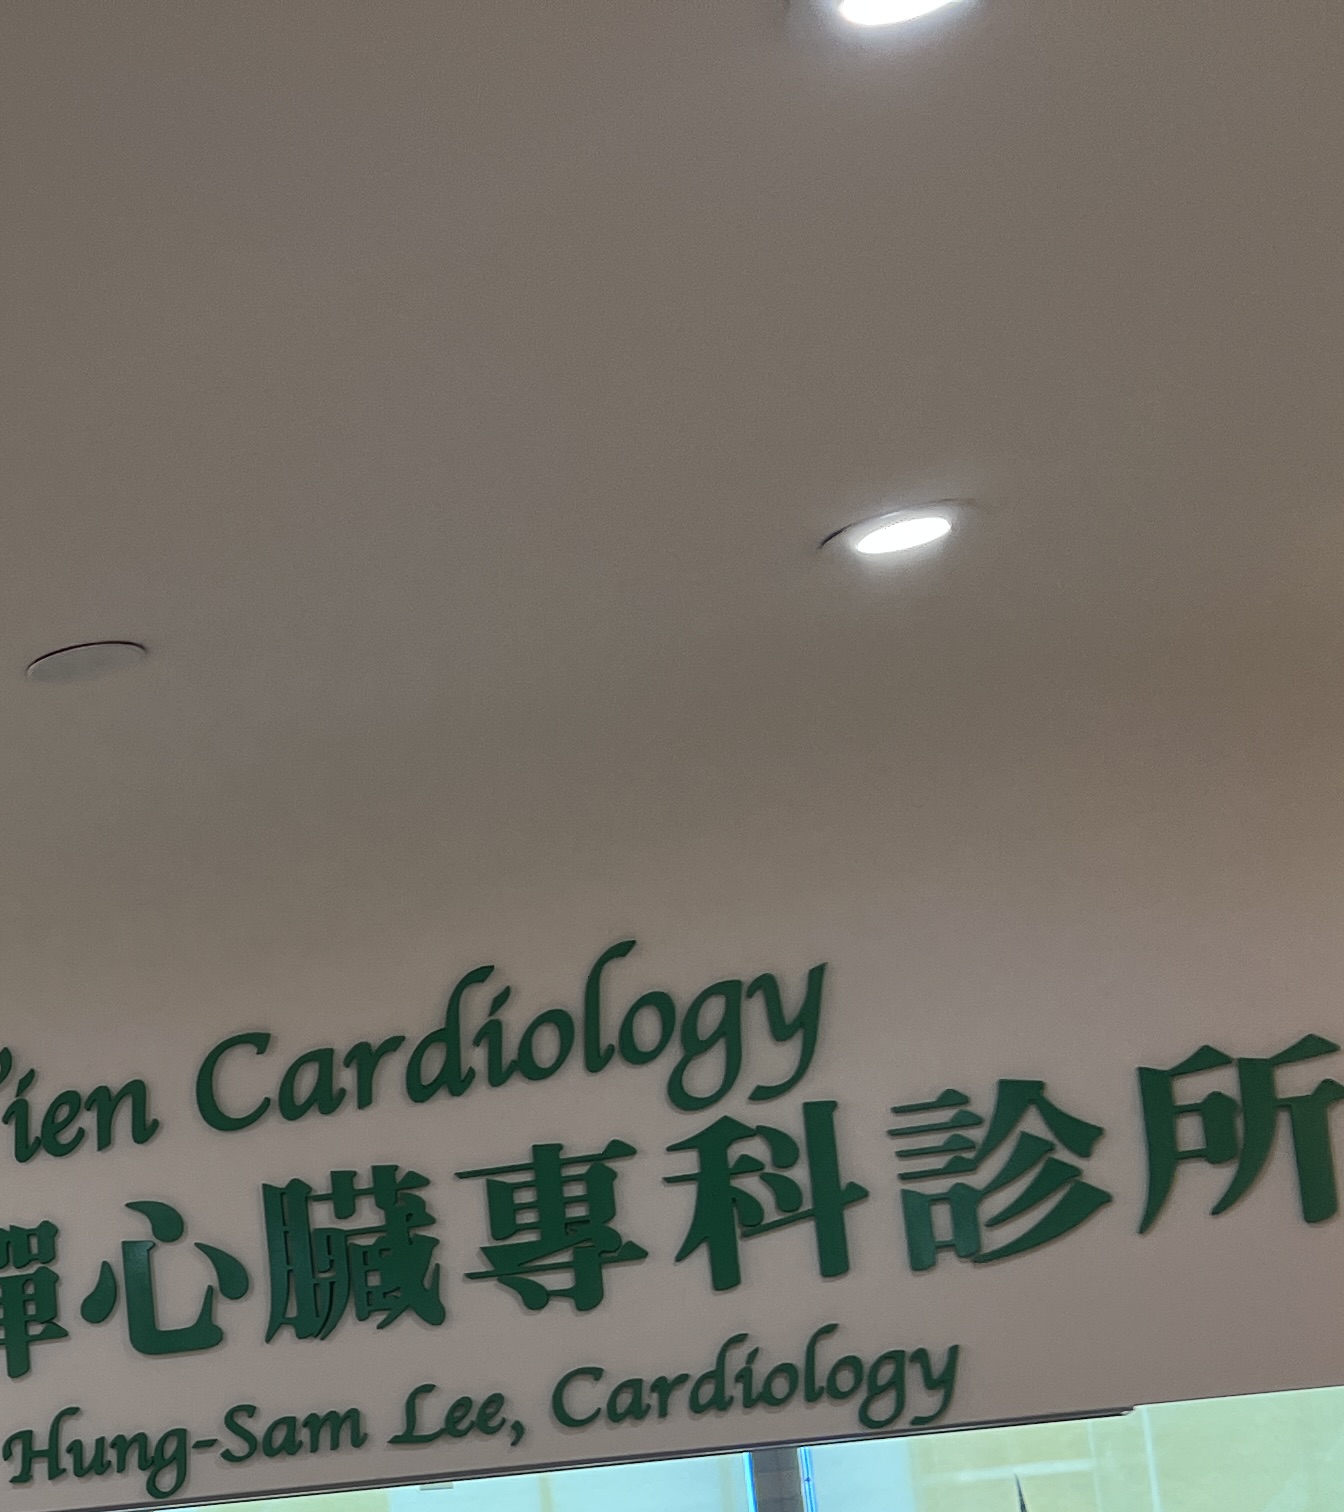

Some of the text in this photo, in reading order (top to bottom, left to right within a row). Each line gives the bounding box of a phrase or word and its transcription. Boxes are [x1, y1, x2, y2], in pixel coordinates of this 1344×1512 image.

[196, 941, 829, 1134] Cardiology
[2, 1380, 369, 1500] Hung-Sam
[392, 1378, 526, 1452] Lee,
[552, 1322, 961, 1432] Cardiology
